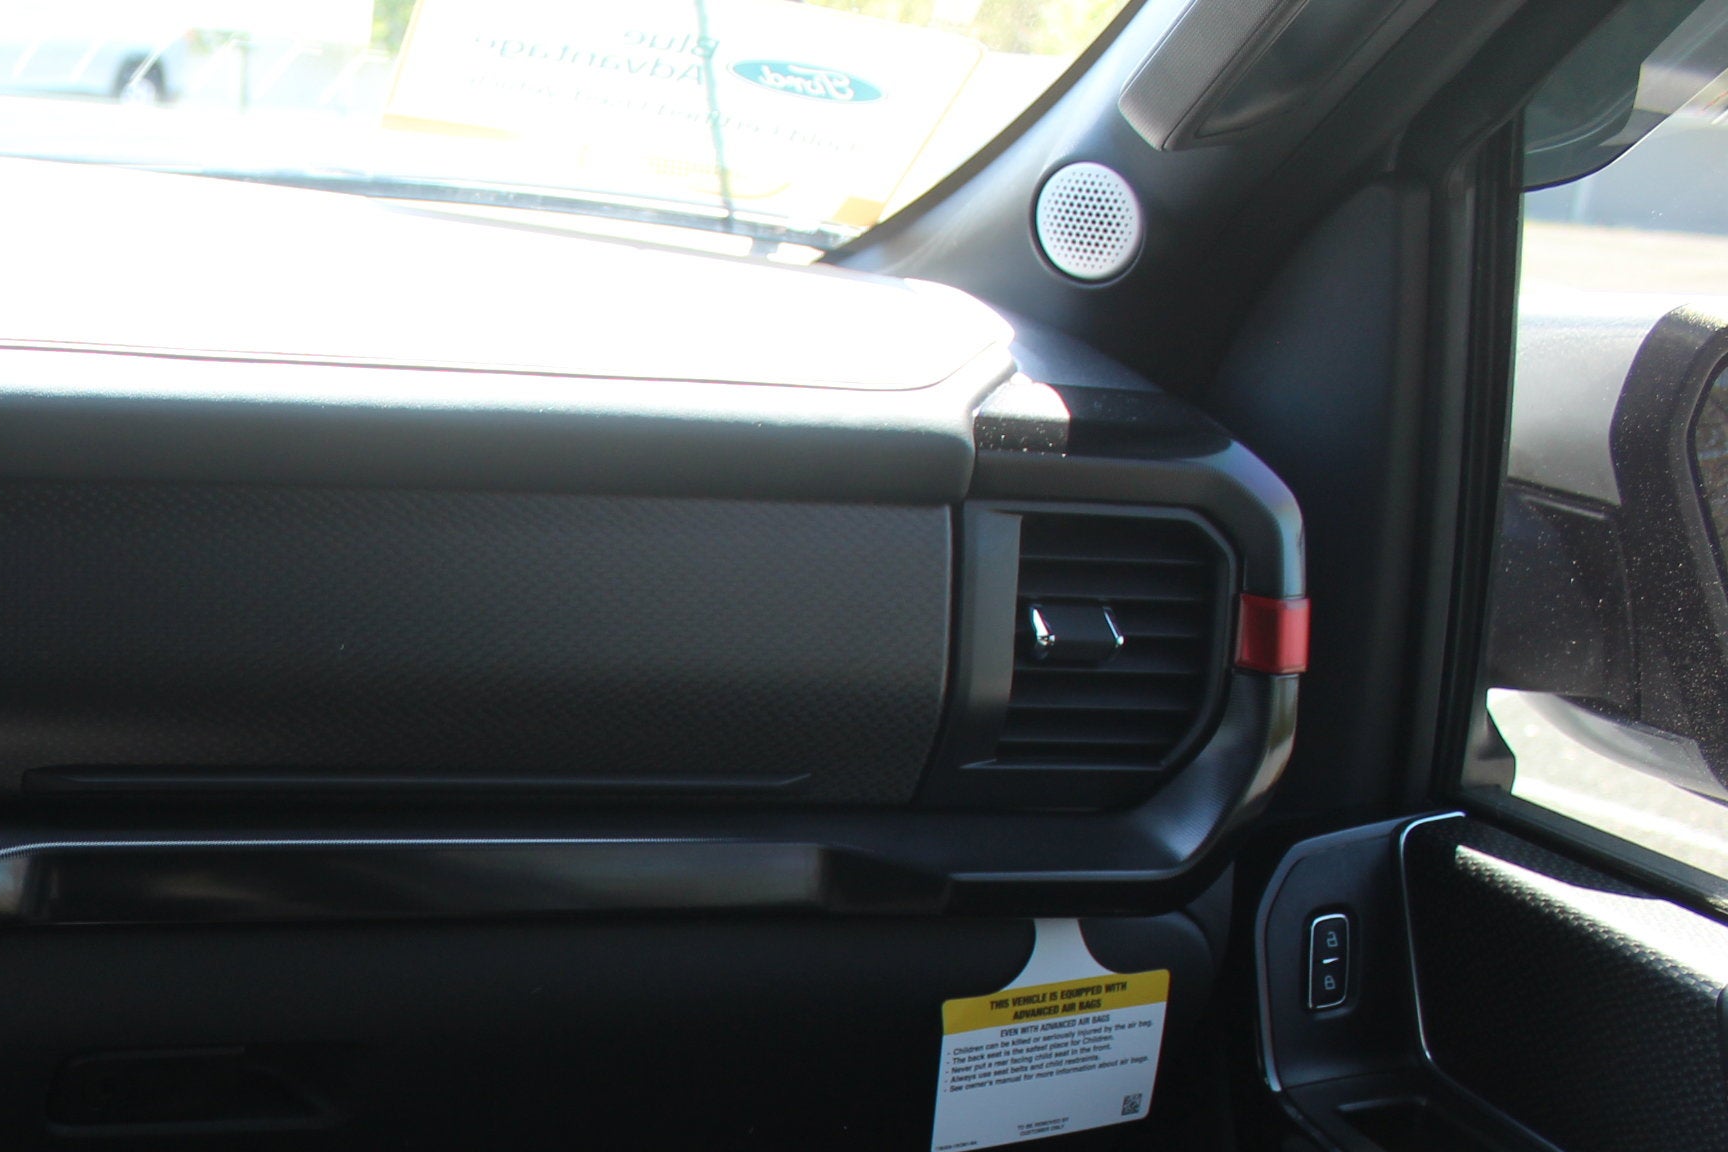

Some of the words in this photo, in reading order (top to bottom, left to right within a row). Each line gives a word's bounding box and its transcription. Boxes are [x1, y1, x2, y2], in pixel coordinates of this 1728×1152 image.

[990, 998, 1009, 1009] THIS
[1012, 993, 1046, 1006] VEHICLE
[1049, 991, 1057, 1001] IS
[1060, 985, 1102, 1000] EQUIPPED
[1104, 982, 1127, 994] WITH
[1013, 1005, 1059, 1019] ADVANCED
[1061, 1002, 1075, 1012] AIR
[1078, 999, 1101, 1010] BAGS
[1000, 1027, 1018, 1036] EVEN
[1020, 1025, 1038, 1033] WITH
[1040, 1019, 1076, 1031] ADVANCED
[1079, 1017, 1090, 1025] AIR
[1092, 1014, 1110, 1023] BAGS
